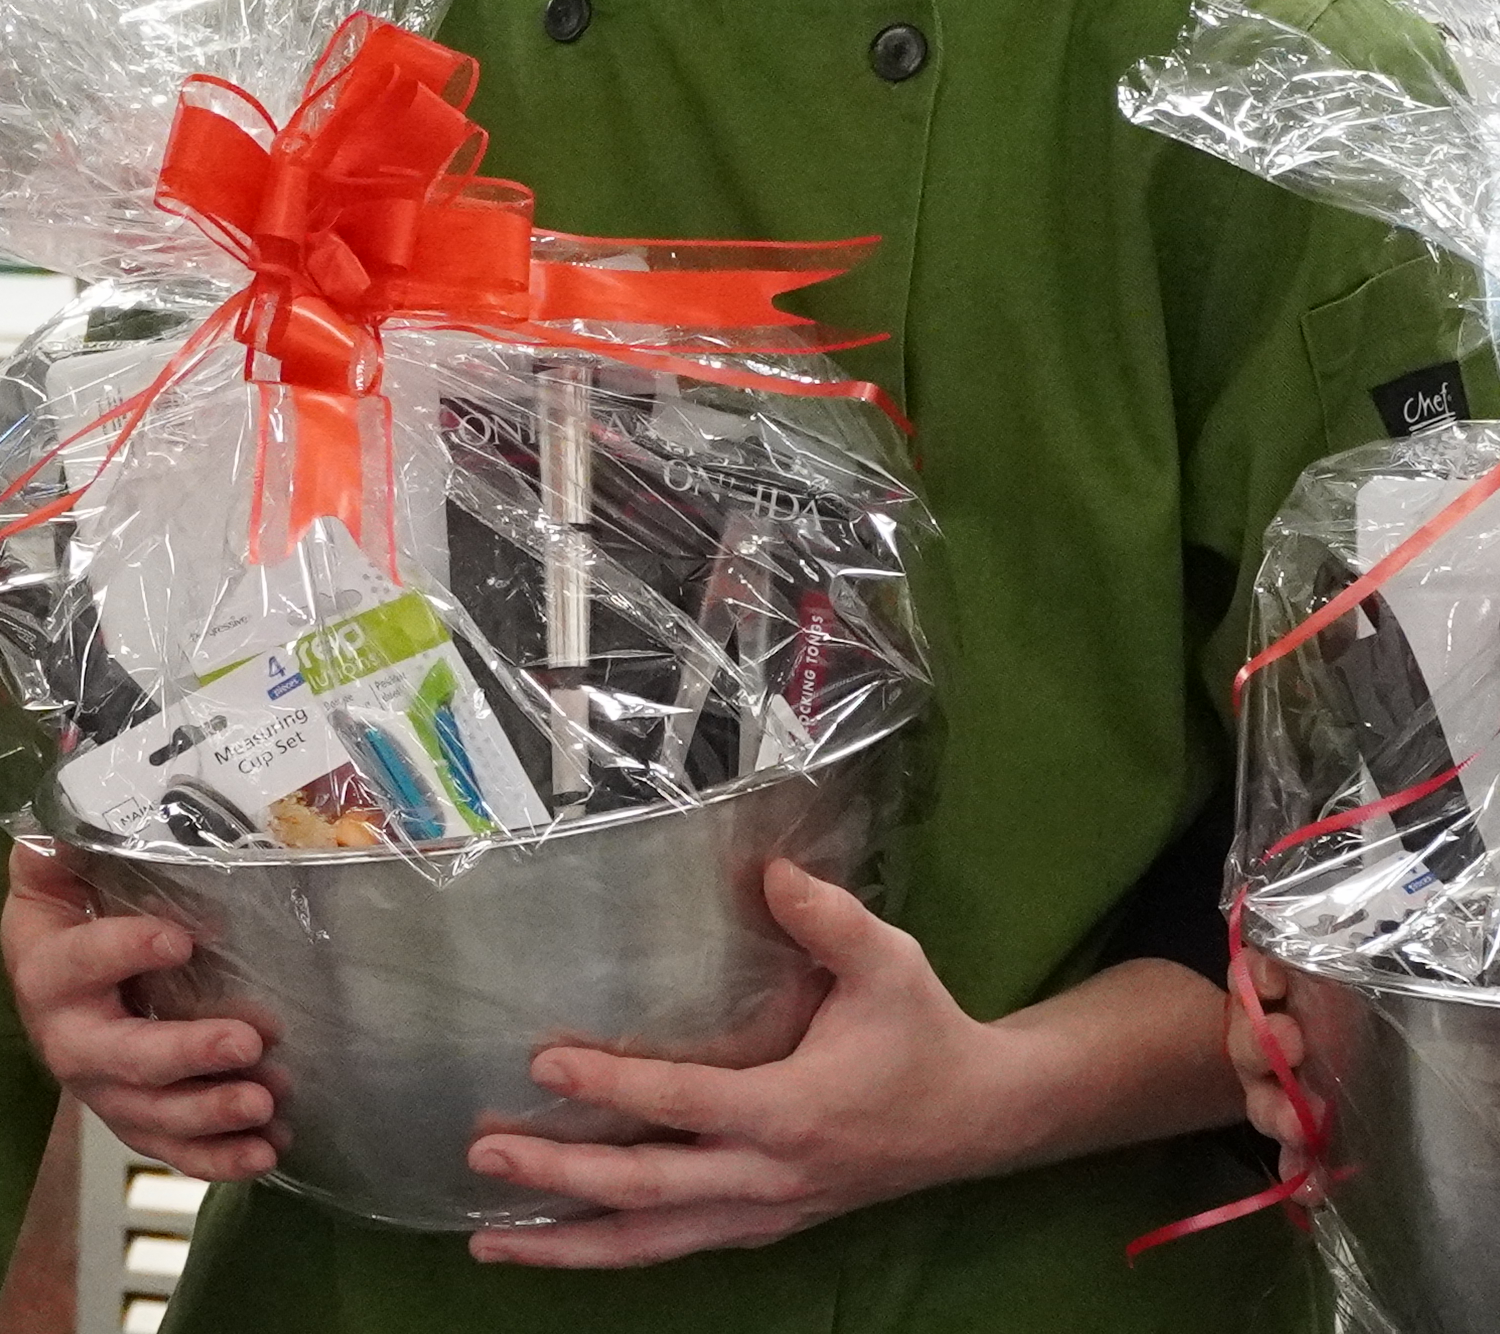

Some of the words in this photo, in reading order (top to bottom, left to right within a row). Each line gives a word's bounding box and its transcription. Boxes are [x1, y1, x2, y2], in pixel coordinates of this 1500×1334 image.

[1403, 382, 1449, 423] Chef
[267, 655, 286, 678] 4
[213, 707, 309, 765] Measuring
[238, 748, 274, 774] Cup
[279, 730, 306, 755] Set
